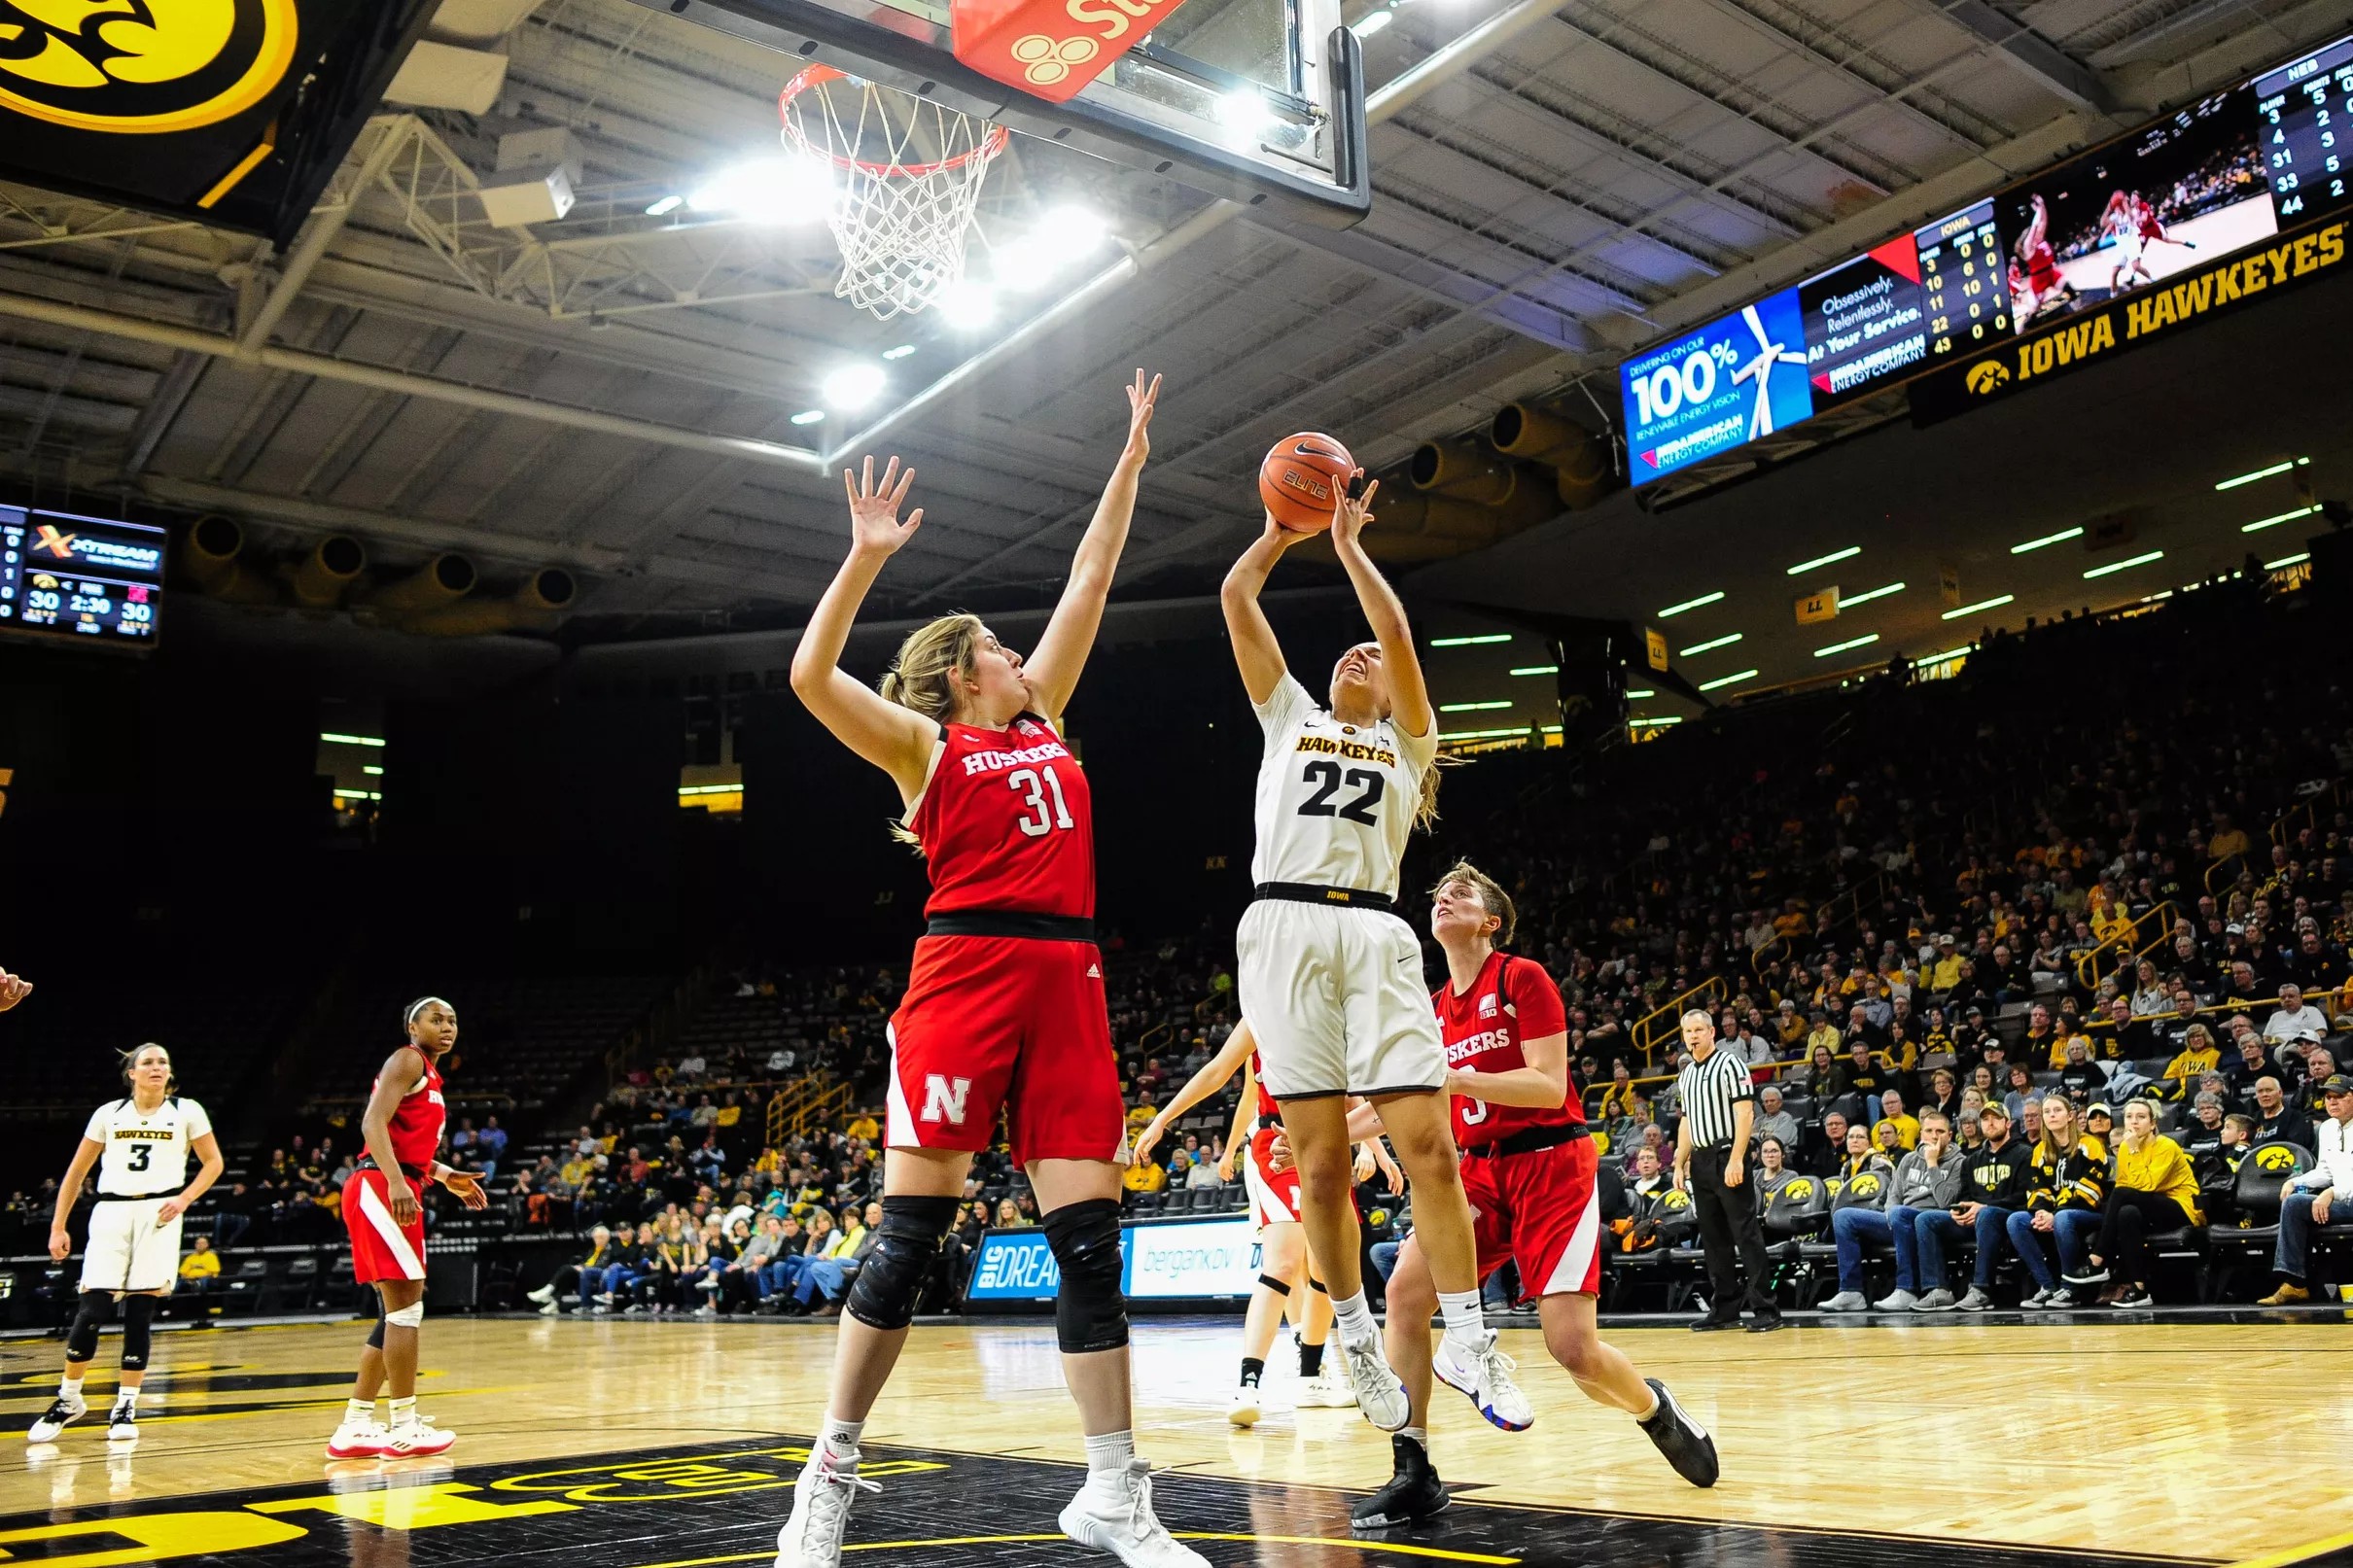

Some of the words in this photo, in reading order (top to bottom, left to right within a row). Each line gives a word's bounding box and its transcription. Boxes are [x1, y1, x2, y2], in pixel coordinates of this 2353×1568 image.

[2287, 58, 2318, 82] NEB
[2260, 94, 2286, 115] PLAYER
[2302, 75, 2331, 94] POINTS
[2268, 108, 2280, 124] 3
[2313, 88, 2327, 105] 5
[2272, 127, 2286, 145] 4
[2316, 110, 2331, 127] 2
[2271, 148, 2292, 168] 31
[2321, 130, 2335, 148] 3
[2276, 172, 2299, 192] 33
[2326, 155, 2340, 173] 5
[2281, 194, 2304, 215] 44
[2331, 179, 2344, 196] 2
[1941, 216, 1971, 237] IOWA
[1926, 274, 1943, 293] 10
[1985, 252, 1997, 267] 0
[1927, 259, 1936, 273] 3
[1960, 243, 1972, 259] 0
[1983, 233, 1994, 248] 0
[1822, 275, 1893, 316] Obsessively.
[1929, 294, 1944, 312] 11
[1962, 279, 1982, 297] 10
[1989, 271, 1998, 286] 1
[2019, 314, 2115, 380] IOWA
[2127, 225, 2344, 340] HAWKEYES
[1827, 296, 1894, 333] Relentlessly.
[1931, 315, 1949, 334] 22
[1969, 302, 1981, 318] 0
[1993, 294, 2002, 309] 1
[1934, 336, 1951, 354] 43
[1972, 324, 1984, 339] 0
[1995, 314, 2007, 331] 0
[1808, 344, 1824, 364] At
[1826, 331, 1861, 354] Your
[1863, 307, 1922, 339] Service.
[1630, 349, 1670, 377] DELIVERING
[1671, 344, 1687, 360] ON
[1686, 336, 1705, 351] OUR
[1829, 333, 1926, 381] MIDAMERICAN
[1631, 338, 1738, 426] 100%
[1831, 368, 1871, 394] ENERGY
[1635, 412, 1678, 441] RENEWABLE
[1680, 403, 1711, 424] ENERGY
[1712, 390, 1740, 410] VISION
[1657, 444, 1693, 470] ENERGY
[1694, 426, 1744, 453] COMPANY
[1283, 469, 1329, 500] ELITE
[28, 590, 60, 610] 30
[69, 594, 112, 614] 2:30
[122, 602, 152, 622] 30
[1808, 601, 1822, 613] LL
[961, 741, 1070, 777] HUSKERS
[1296, 734, 1396, 769] HAWKEYES
[1007, 765, 1074, 837] 31
[1297, 760, 1386, 827] 22
[1326, 890, 1350, 902] IOWA
[1446, 1028, 1510, 1063] SKERS
[920, 1073, 971, 1125] N
[114, 1131, 173, 1140] HAWKEYES
[127, 1144, 153, 1171] 3
[977, 1244, 1003, 1288] BIG
[996, 1244, 1061, 1288] DREA
